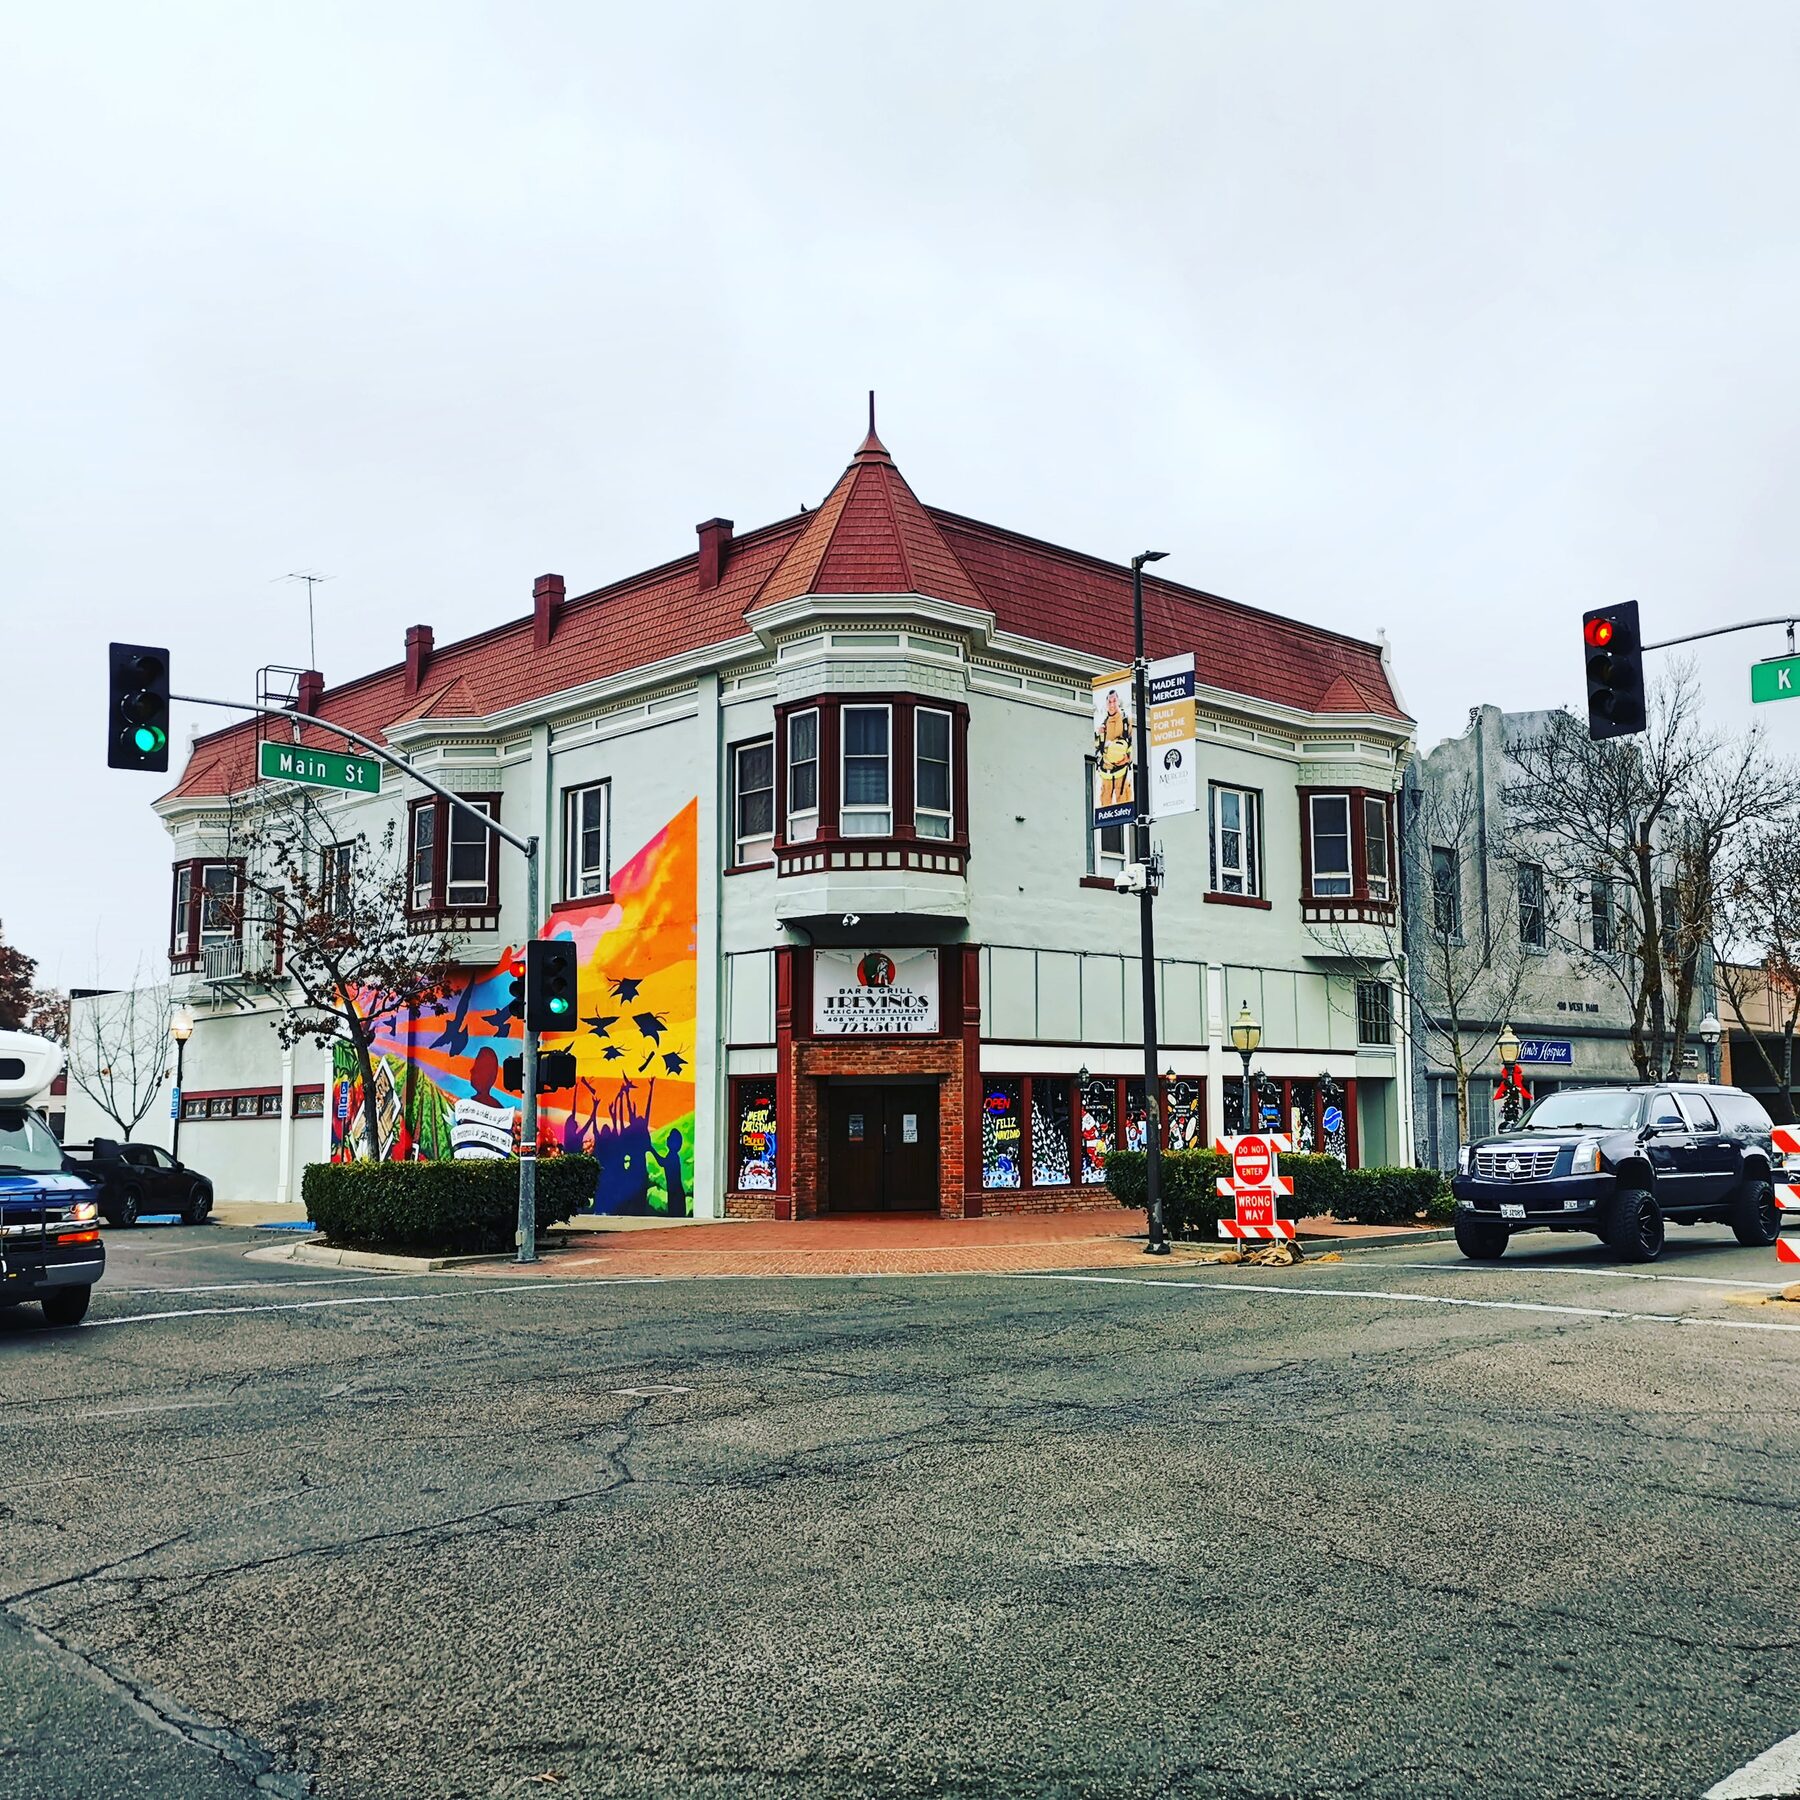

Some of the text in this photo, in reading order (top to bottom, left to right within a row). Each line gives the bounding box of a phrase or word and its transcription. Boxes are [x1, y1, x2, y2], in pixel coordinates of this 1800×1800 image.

[1152, 676, 1186, 691] MADE IN
[1778, 668, 1792, 690] K
[1152, 688, 1187, 702] MERCED.
[1153, 708, 1175, 720] BUILT
[1153, 717, 1185, 731] FOR THE
[1153, 729, 1185, 742] WORLD.
[280, 753, 364, 784] Main St
[1098, 807, 1132, 820] Public Safety
[824, 994, 929, 1008] TREVIÑOS
[840, 1021, 913, 1033] 723.5610
[1538, 1042, 1567, 1061] Hospice
[984, 1097, 1010, 1109] OPEN
[747, 1109, 769, 1123] MERRY
[996, 1116, 1017, 1130] FELIZ
[741, 1120, 777, 1134] CHRISTMAS
[1238, 1145, 1264, 1154] DO NOT
[1242, 1167, 1264, 1176] ENTER
[1238, 1195, 1271, 1207] WRONG
[1245, 1209, 1265, 1221] WAY
